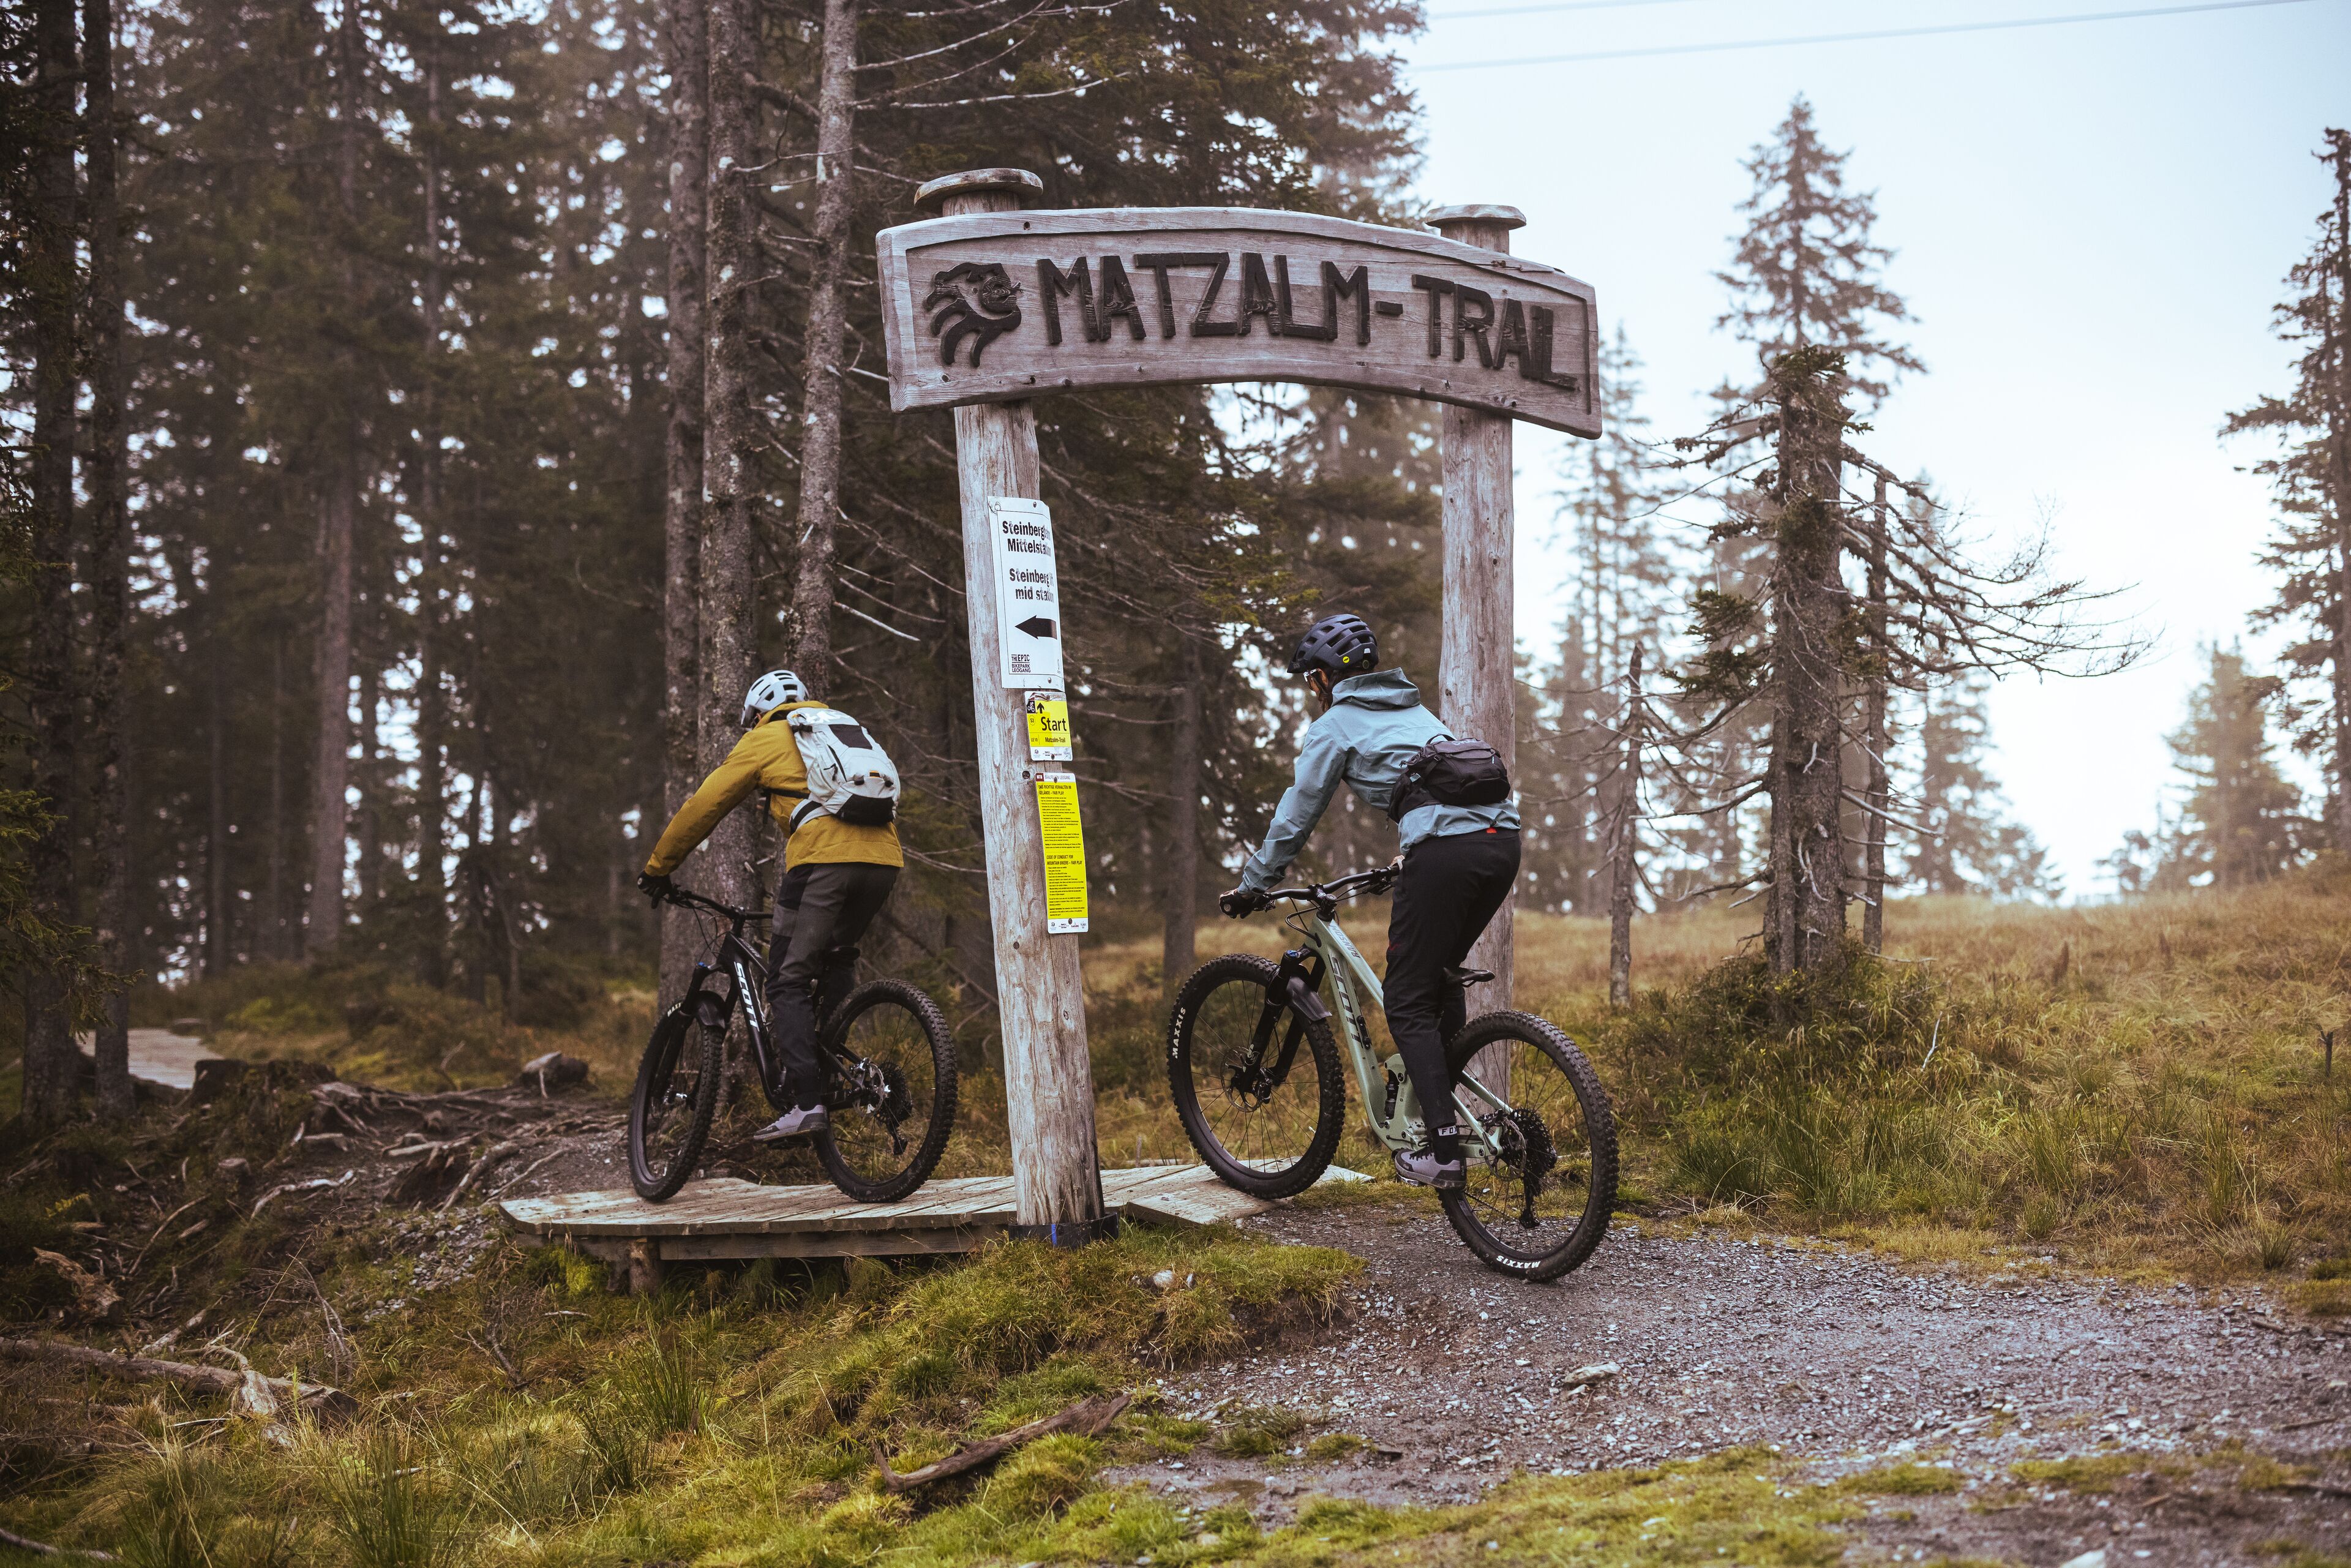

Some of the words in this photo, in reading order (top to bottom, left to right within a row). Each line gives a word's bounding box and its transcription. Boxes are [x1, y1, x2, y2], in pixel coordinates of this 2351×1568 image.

[1037, 252, 1578, 391] MATZALM-TRAIL
[1010, 568, 1049, 587] Steinberg
[1016, 586, 1033, 599] mid
[1041, 716, 1067, 731] Start
[733, 961, 760, 1032] SCOTT
[1328, 953, 1363, 1049] SCOTT
[1172, 1007, 1186, 1059] MAXXIS
[1496, 1255, 1540, 1269] MAXXIS
